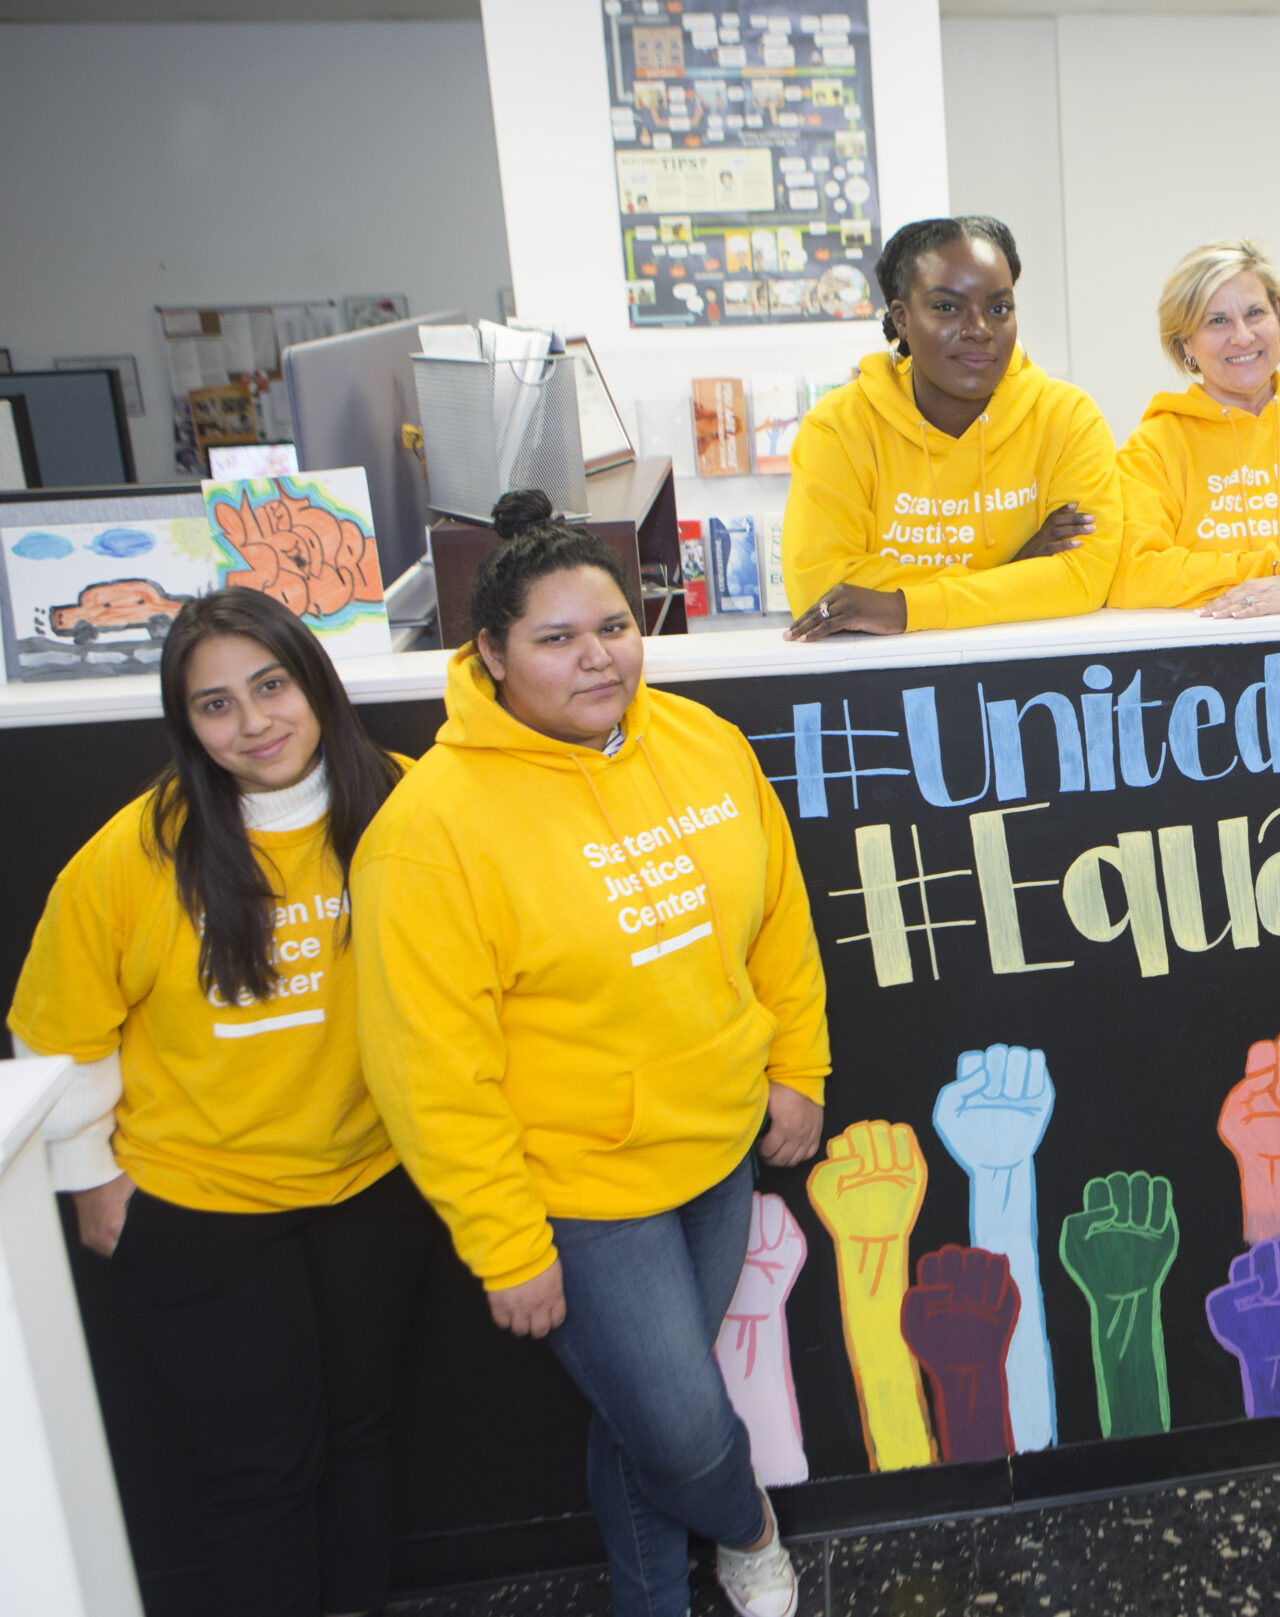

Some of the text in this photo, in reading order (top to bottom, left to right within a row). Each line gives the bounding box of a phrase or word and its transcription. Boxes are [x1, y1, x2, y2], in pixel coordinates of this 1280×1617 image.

[974, 476, 1038, 513] Island
[882, 520, 975, 544] Justice
[582, 793, 739, 868] Staten Island
[604, 855, 695, 902] Justice
[618, 884, 706, 934] Center
[208, 970, 324, 1008] Ceter
